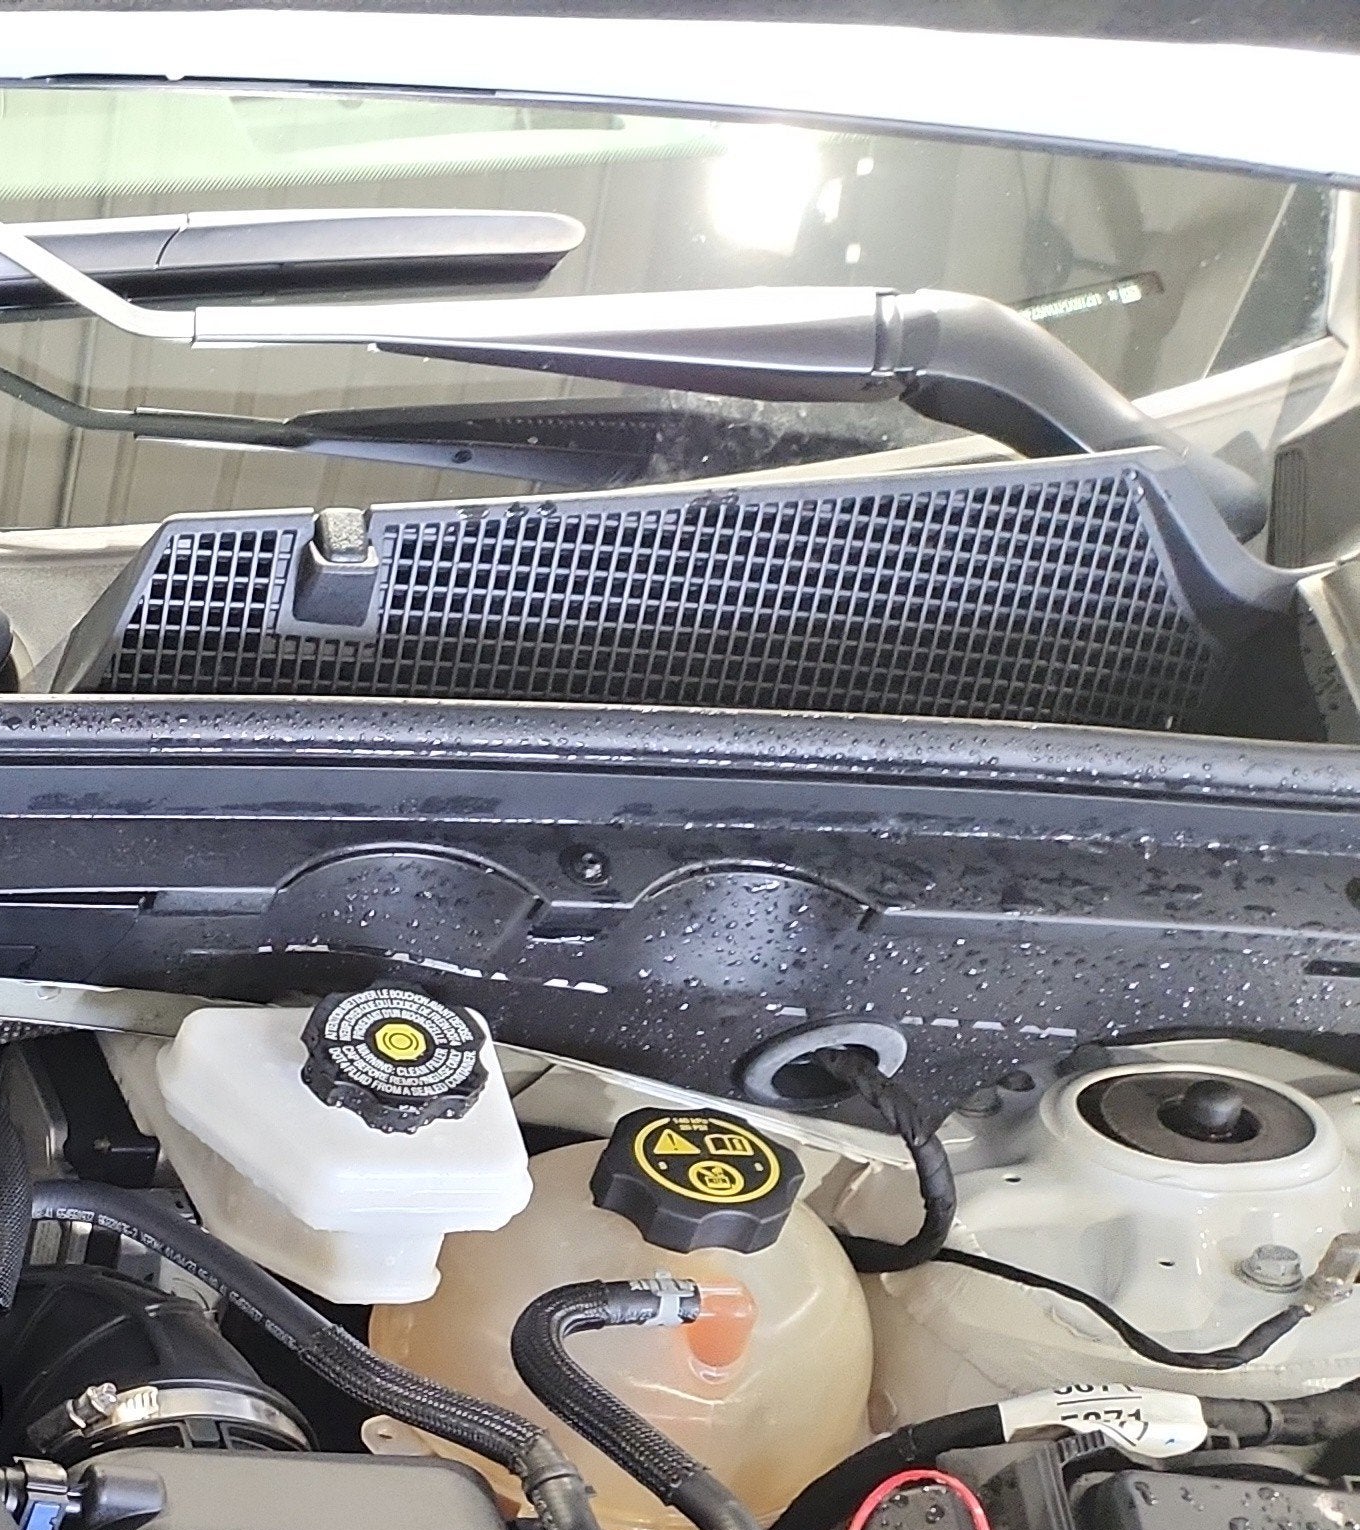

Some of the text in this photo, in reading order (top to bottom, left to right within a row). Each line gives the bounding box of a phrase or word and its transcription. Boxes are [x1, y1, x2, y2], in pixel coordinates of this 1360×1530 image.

[341, 1045, 361, 1062] CAP
[352, 1058, 389, 1082] BEFORE
[395, 1064, 431, 1076] CLEAN
[424, 1047, 447, 1071] FILLER
[343, 1065, 373, 1086] FLUID
[369, 1079, 401, 1096] FROM
[410, 1081, 450, 1097] SEALED
